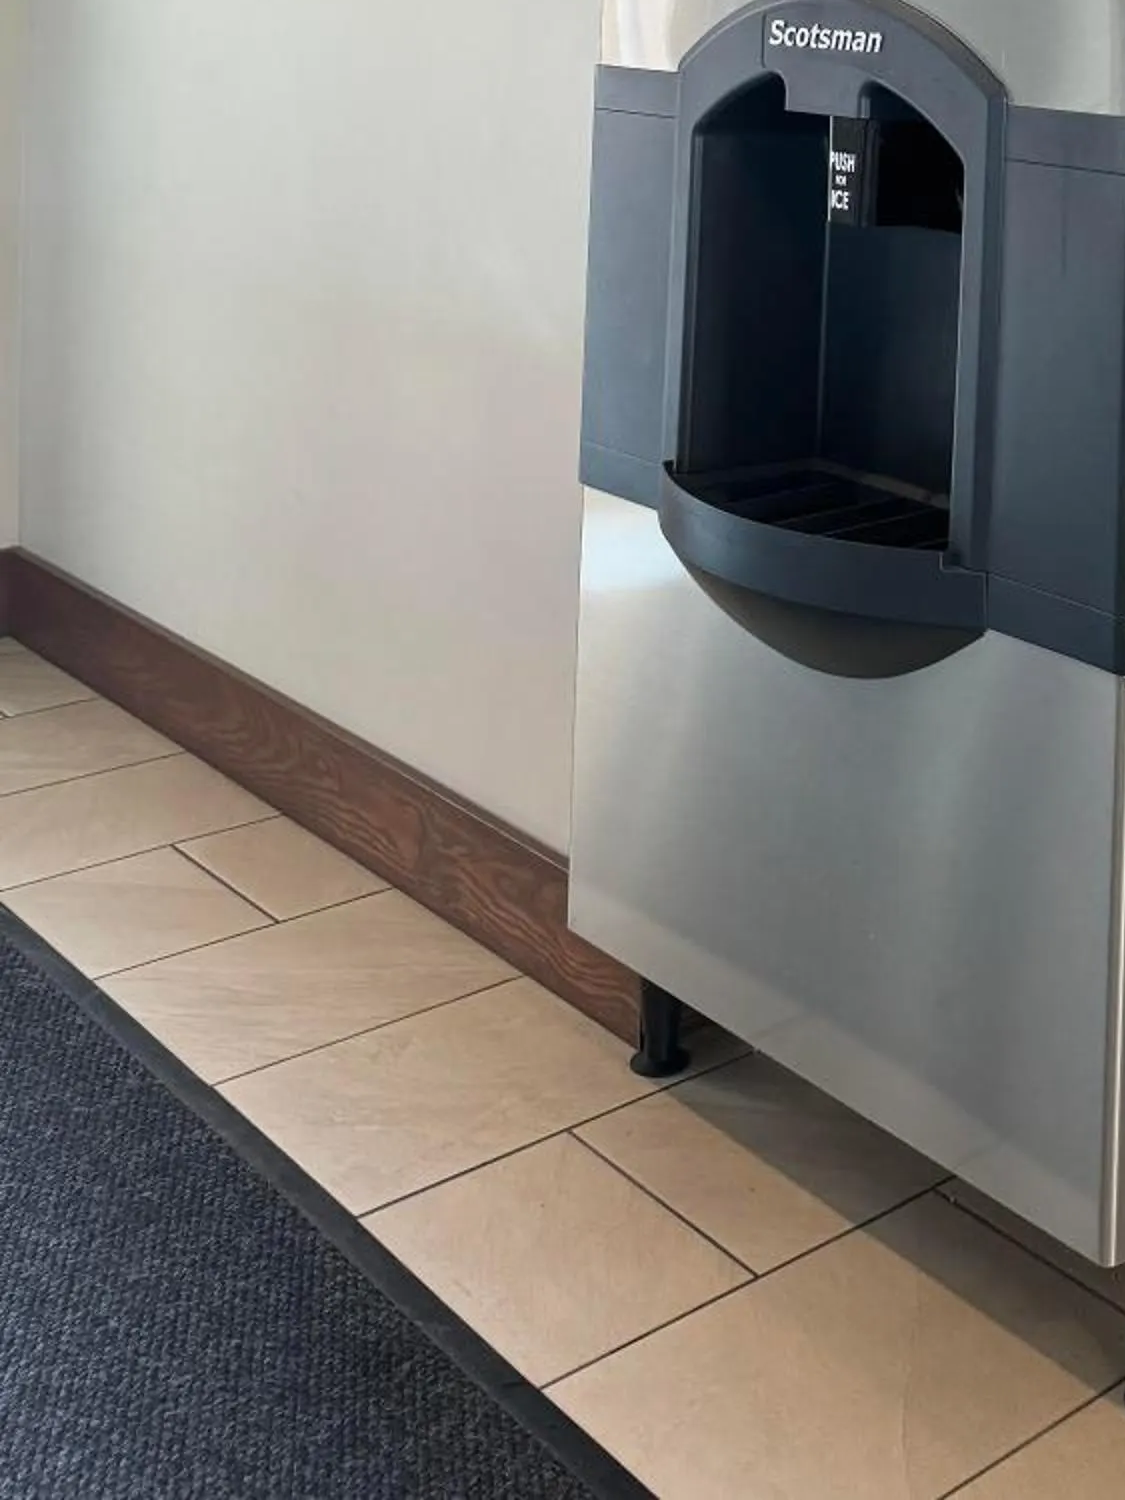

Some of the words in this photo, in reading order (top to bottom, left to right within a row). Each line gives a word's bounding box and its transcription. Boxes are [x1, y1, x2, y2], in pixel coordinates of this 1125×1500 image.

[768, 19, 882, 53] Scotsman
[830, 151, 856, 172] PUSH
[831, 189, 849, 210] ICE
